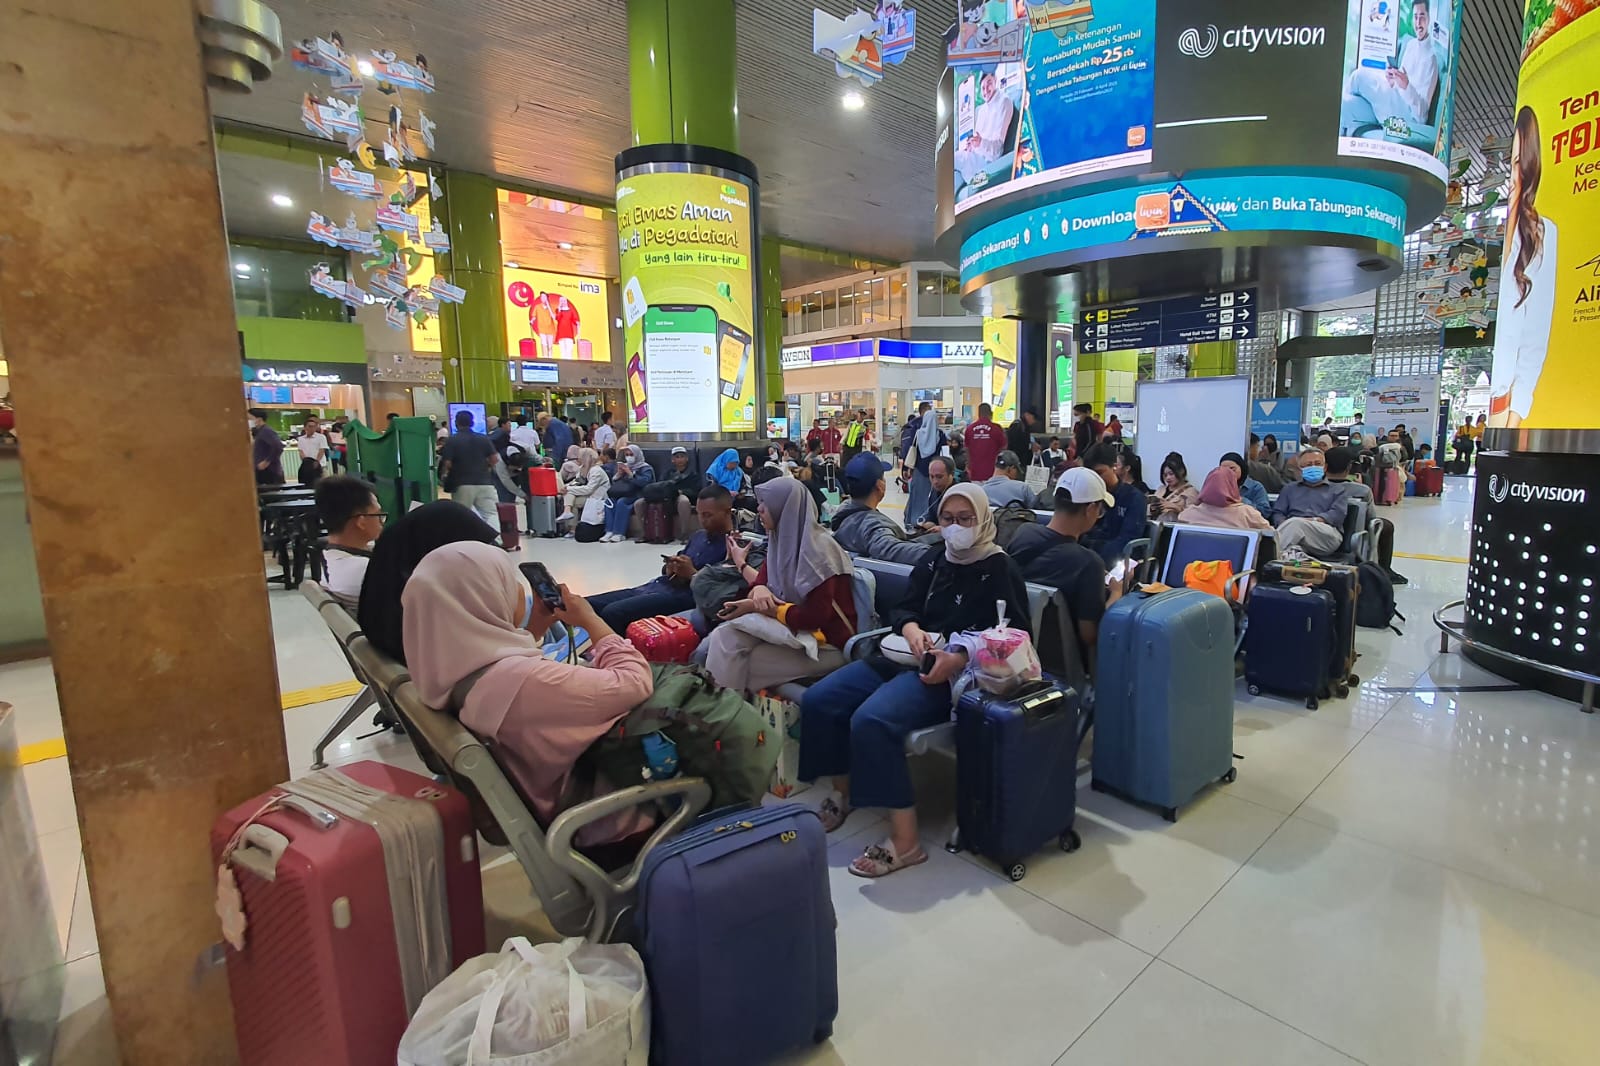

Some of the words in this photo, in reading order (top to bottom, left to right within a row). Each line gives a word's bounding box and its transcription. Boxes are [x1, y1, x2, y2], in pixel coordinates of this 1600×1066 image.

[1042, 46, 1081, 65] Menabung
[1082, 39, 1111, 51] Mudah
[1112, 29, 1142, 44] Sambil
[1058, 37, 1074, 48] Raih
[1075, 24, 1122, 40] Ketenangan
[1222, 24, 1326, 52] cityvision
[1036, 84, 1057, 96] Dengan
[1058, 80, 1072, 90] buka
[1072, 71, 1102, 86] Tabungan
[1104, 65, 1120, 75] NOW
[1121, 62, 1128, 71] di
[1046, 60, 1090, 80] Bersedekah
[634, 203, 678, 225] Emas
[681, 200, 733, 222] Aman
[1072, 210, 1136, 231] Downloa
[1242, 198, 1269, 210] dan
[1272, 197, 1307, 210] Buka
[1308, 198, 1364, 218] Tabungan
[1364, 205, 1398, 229] Sekarang!
[630, 228, 641, 250] di
[644, 224, 740, 248] Pegadaian!
[982, 232, 1020, 257] Sekarang!
[674, 252, 694, 263] lain
[698, 252, 740, 266] tiru-tiru!
[1510, 482, 1586, 503] cityvision
